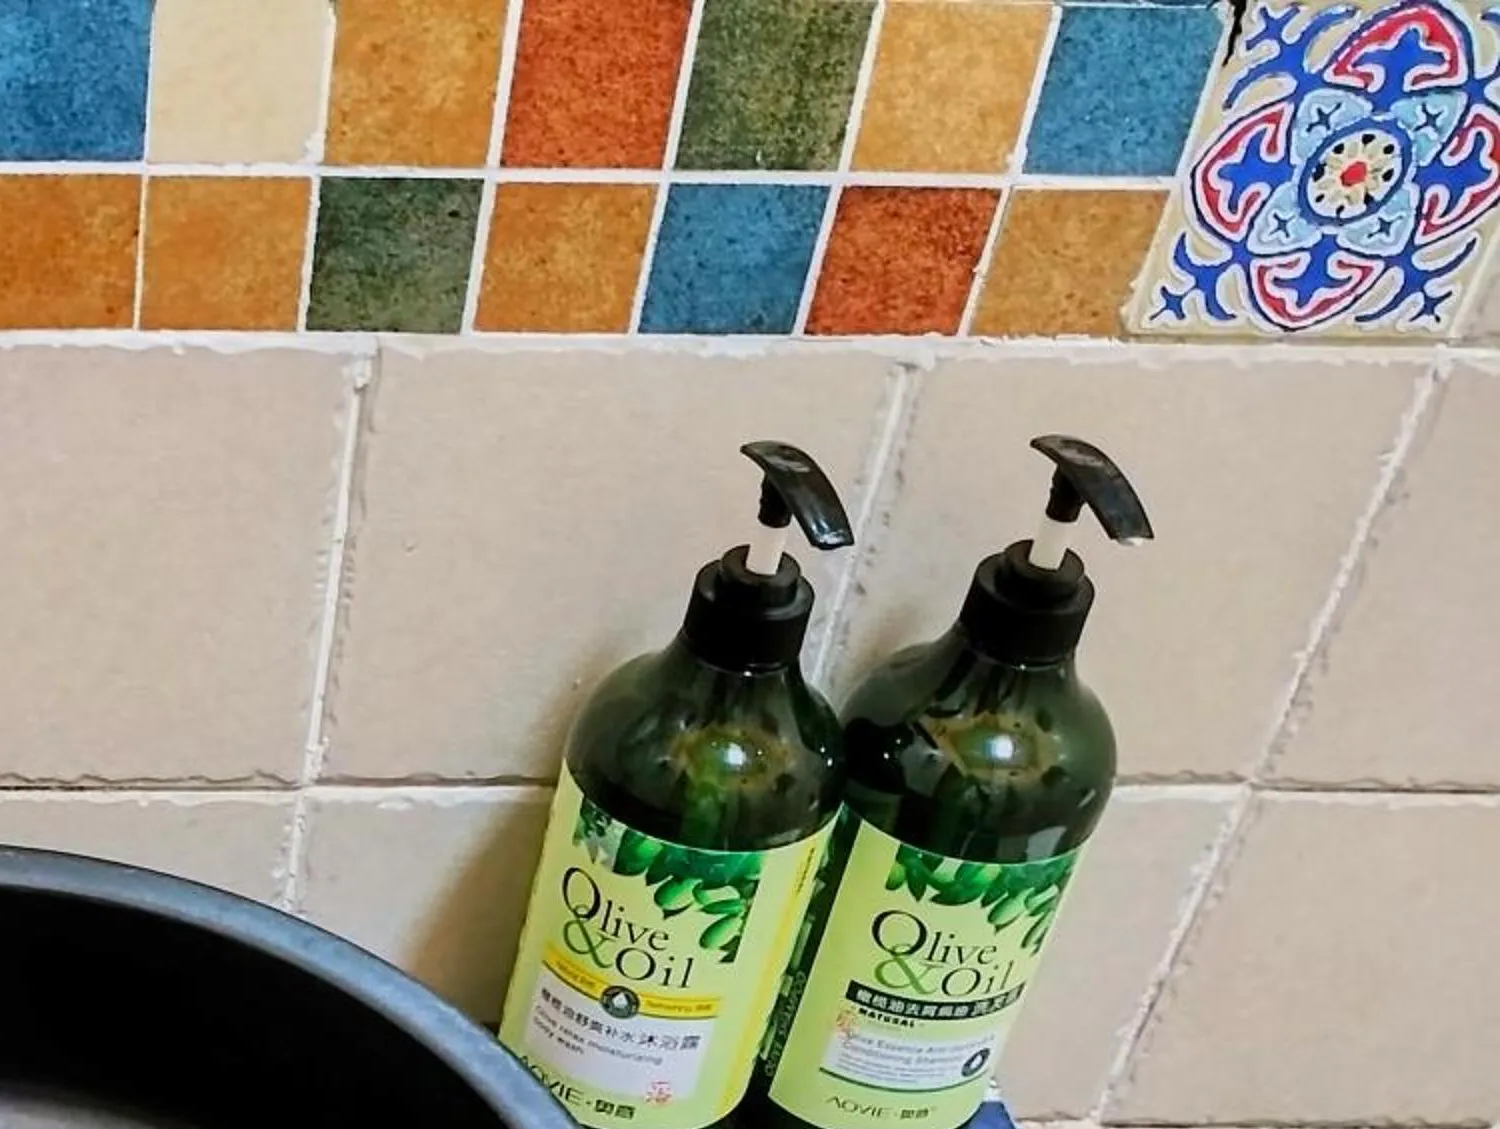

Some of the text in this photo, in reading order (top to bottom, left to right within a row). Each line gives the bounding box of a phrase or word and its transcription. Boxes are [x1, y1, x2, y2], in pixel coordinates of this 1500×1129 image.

[562, 867, 670, 951] Olive
[871, 909, 997, 965] Olive
[615, 946, 695, 988] Oil
[941, 959, 1015, 997] Oil
